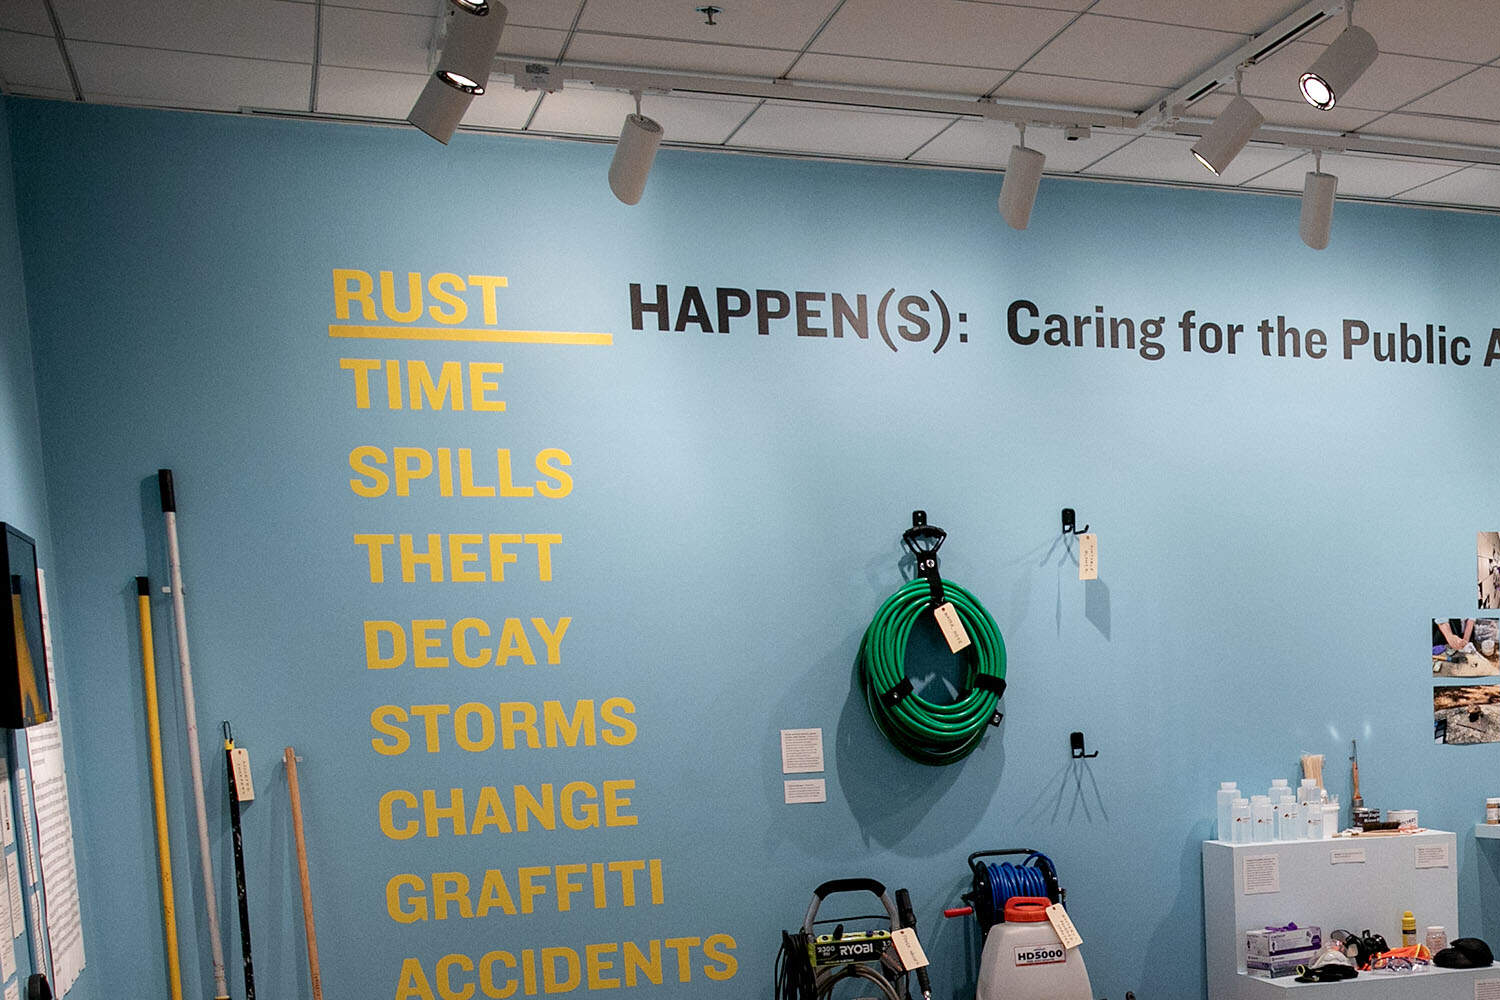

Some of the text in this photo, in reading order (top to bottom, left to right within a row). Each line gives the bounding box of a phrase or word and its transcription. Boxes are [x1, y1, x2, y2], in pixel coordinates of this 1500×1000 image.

[333, 268, 508, 325] RUST
[629, 282, 969, 354] HAPPEN(S):
[1007, 300, 1166, 361] Caring
[1178, 310, 1244, 355] for
[1257, 315, 1328, 359] the
[1343, 319, 1471, 366] Public
[340, 358, 506, 412] TIME
[349, 445, 573, 499] SPILLS
[354, 533, 563, 583] THEFT
[364, 617, 572, 670] DECAY
[370, 697, 637, 756] STORMS
[378, 779, 638, 841] CHANGE
[385, 859, 665, 924] GRAFFITI
[839, 943, 874, 956] RYOBI
[1017, 949, 1063, 961] HD5000
